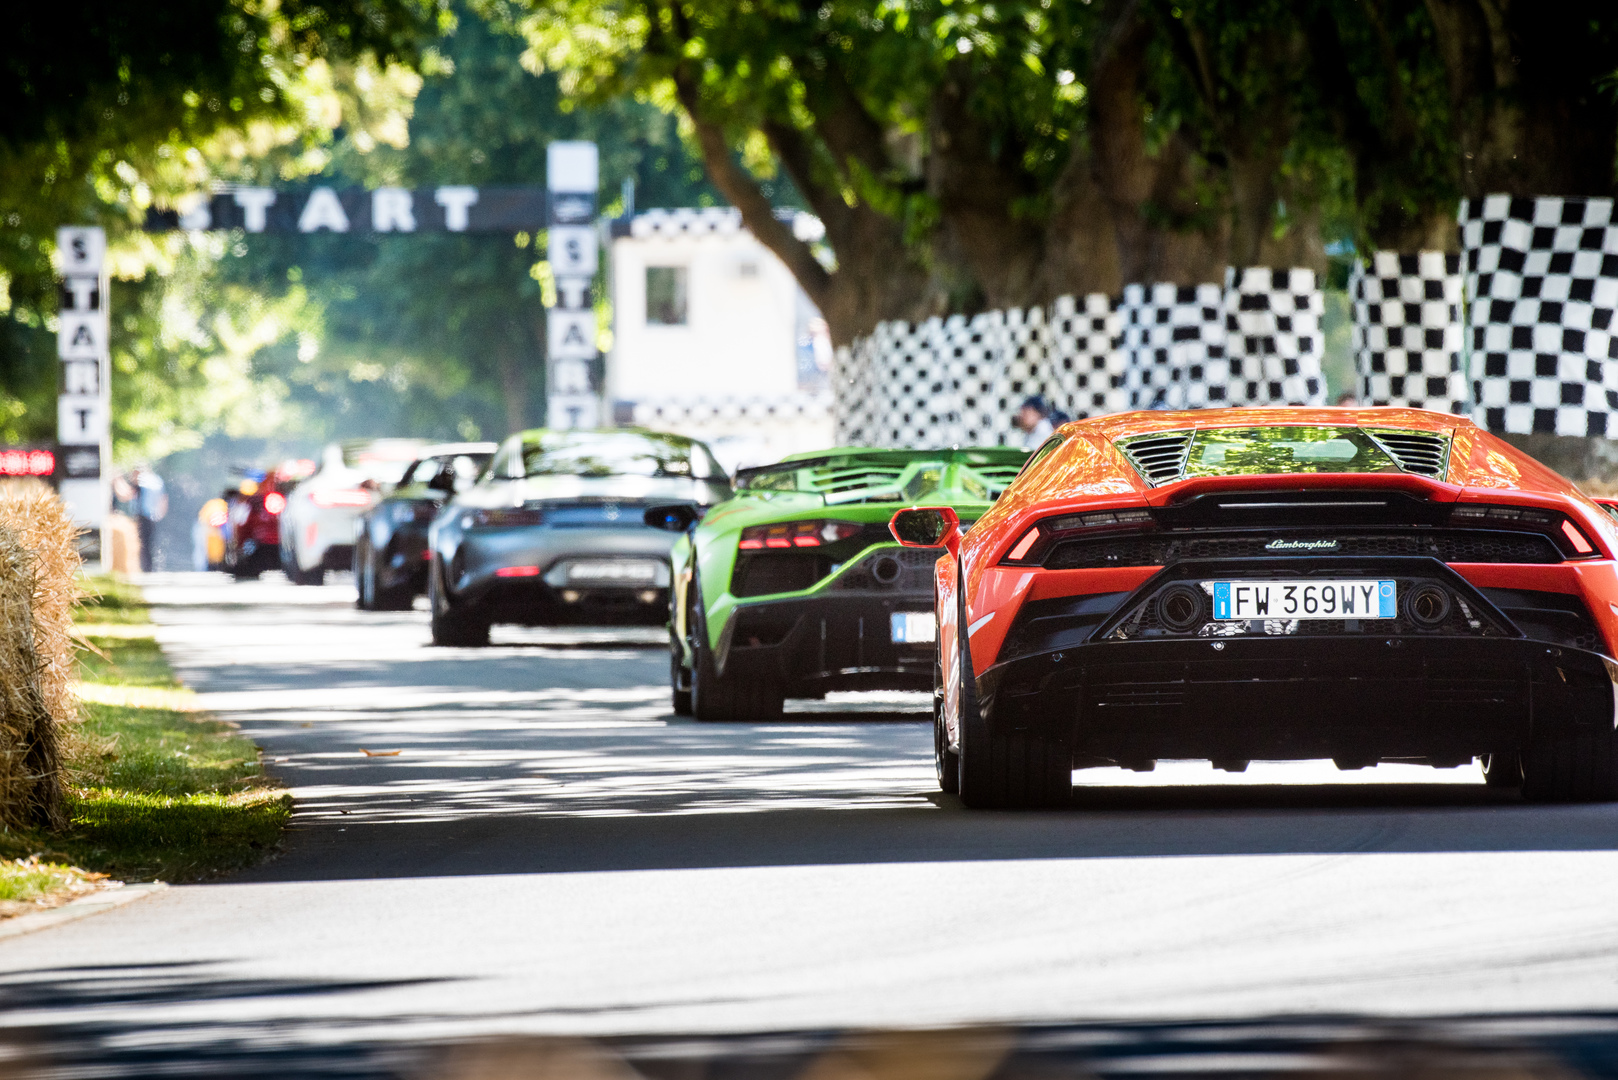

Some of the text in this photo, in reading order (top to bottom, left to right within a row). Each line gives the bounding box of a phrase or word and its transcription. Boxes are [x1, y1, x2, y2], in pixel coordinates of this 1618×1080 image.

[65, 236, 99, 433] START
[1265, 539, 1337, 550] Lamborghini
[1236, 586, 1270, 616] FW
[1283, 585, 1374, 615] 369WY
